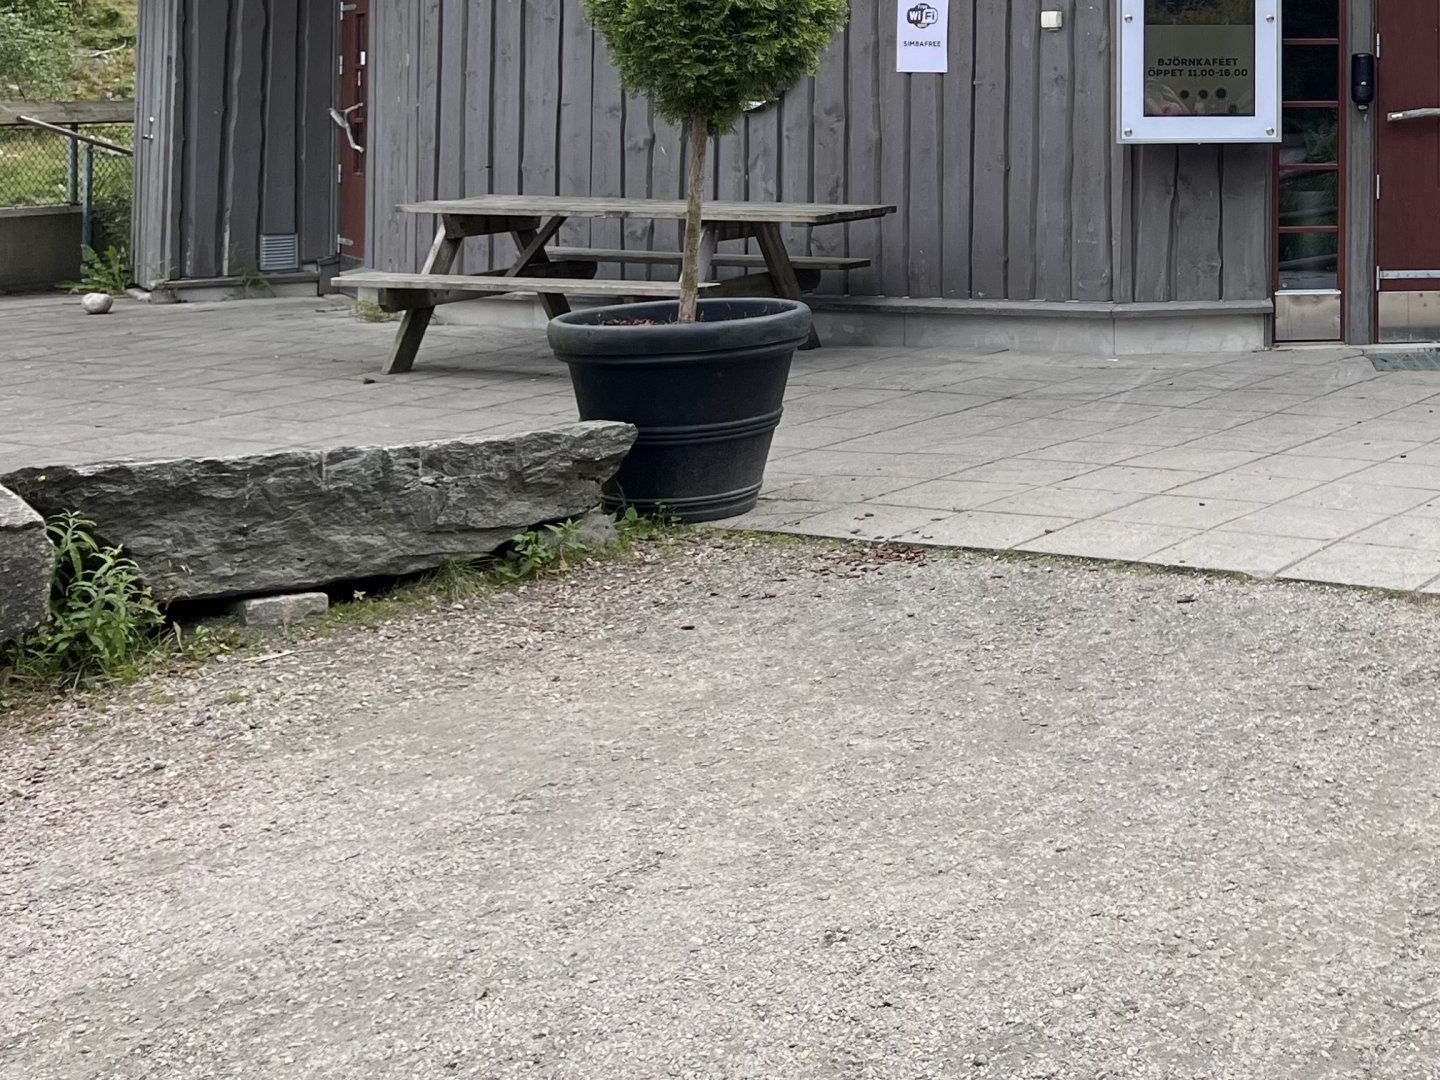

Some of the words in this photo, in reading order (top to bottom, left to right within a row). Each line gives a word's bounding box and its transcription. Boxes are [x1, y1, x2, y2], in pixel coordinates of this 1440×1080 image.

[903, 40, 941, 48] SIMBAFREE
[1157, 56, 1239, 67] BJÖRNKAFÉET
[1147, 67, 1184, 77] ÖPPET
